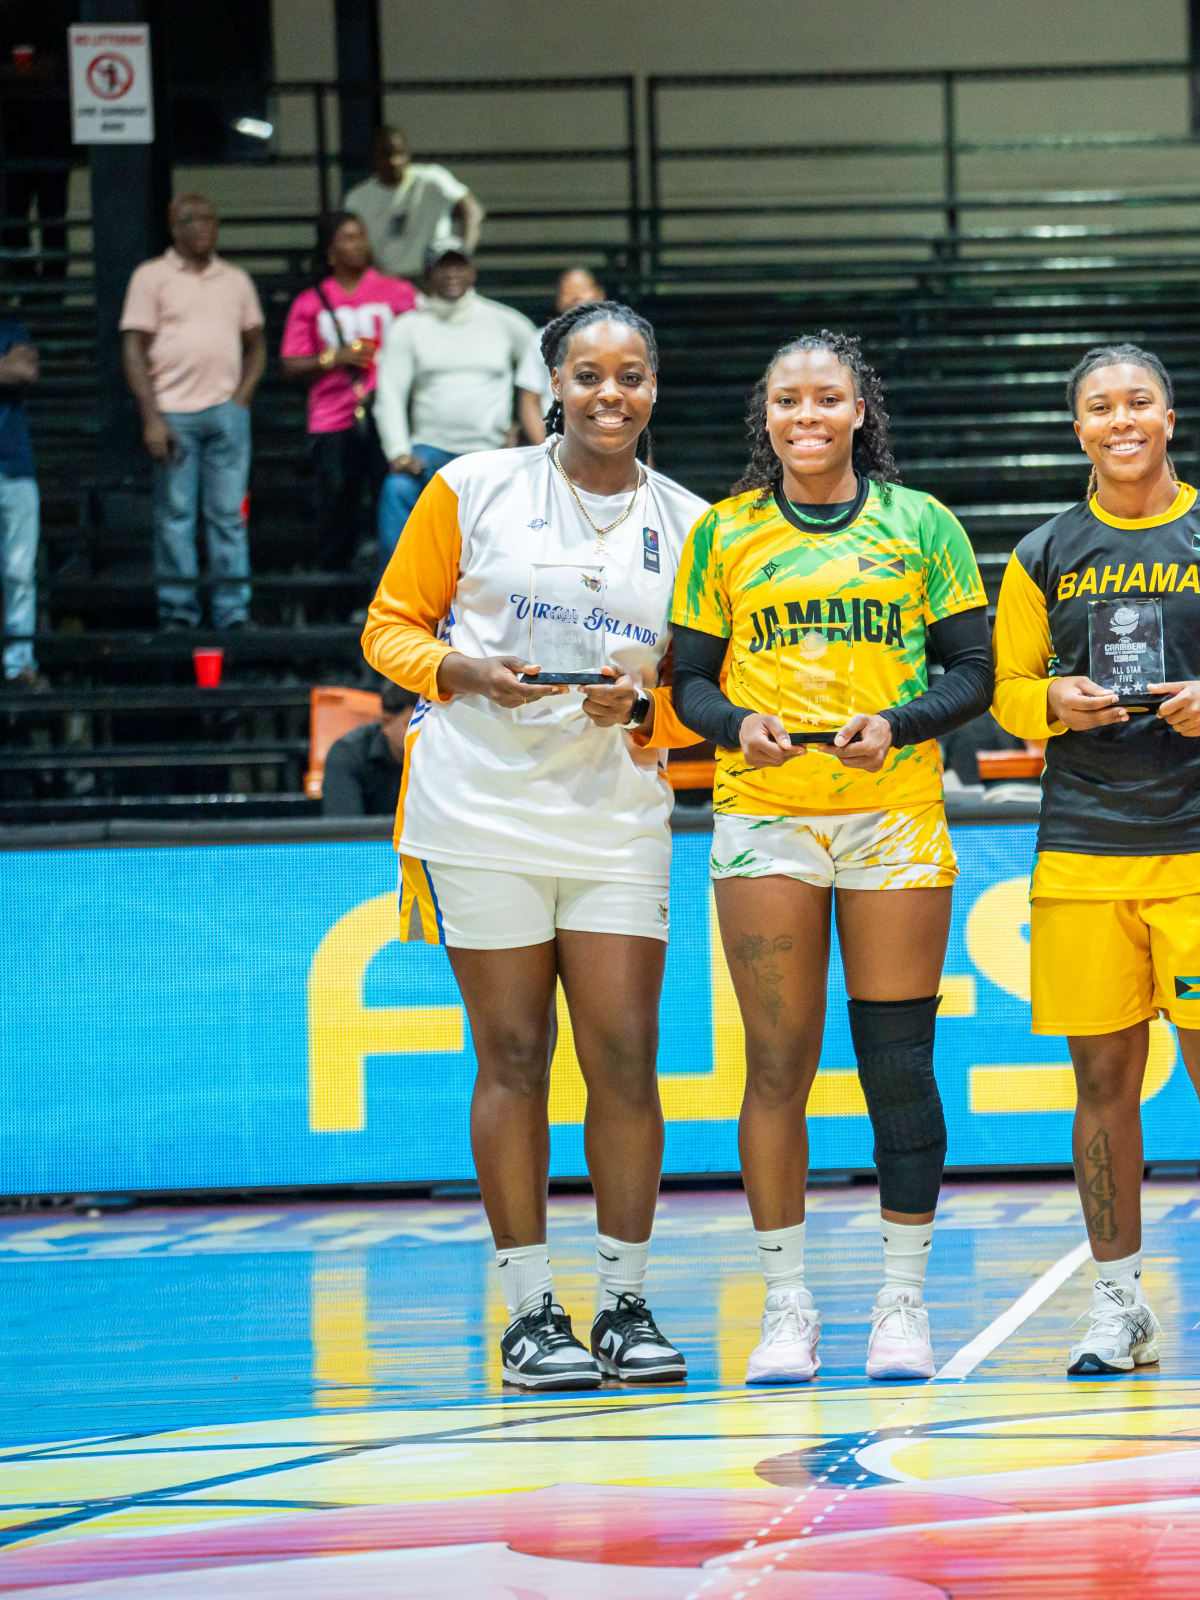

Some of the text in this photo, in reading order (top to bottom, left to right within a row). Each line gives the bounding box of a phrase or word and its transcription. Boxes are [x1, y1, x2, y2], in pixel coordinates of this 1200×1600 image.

[749, 598, 906, 653] JAMAICA
[1104, 642, 1147, 652] CARIBBEAN
[1112, 665, 1142, 675] ALL STAR
[1119, 674, 1133, 682] FIVE
